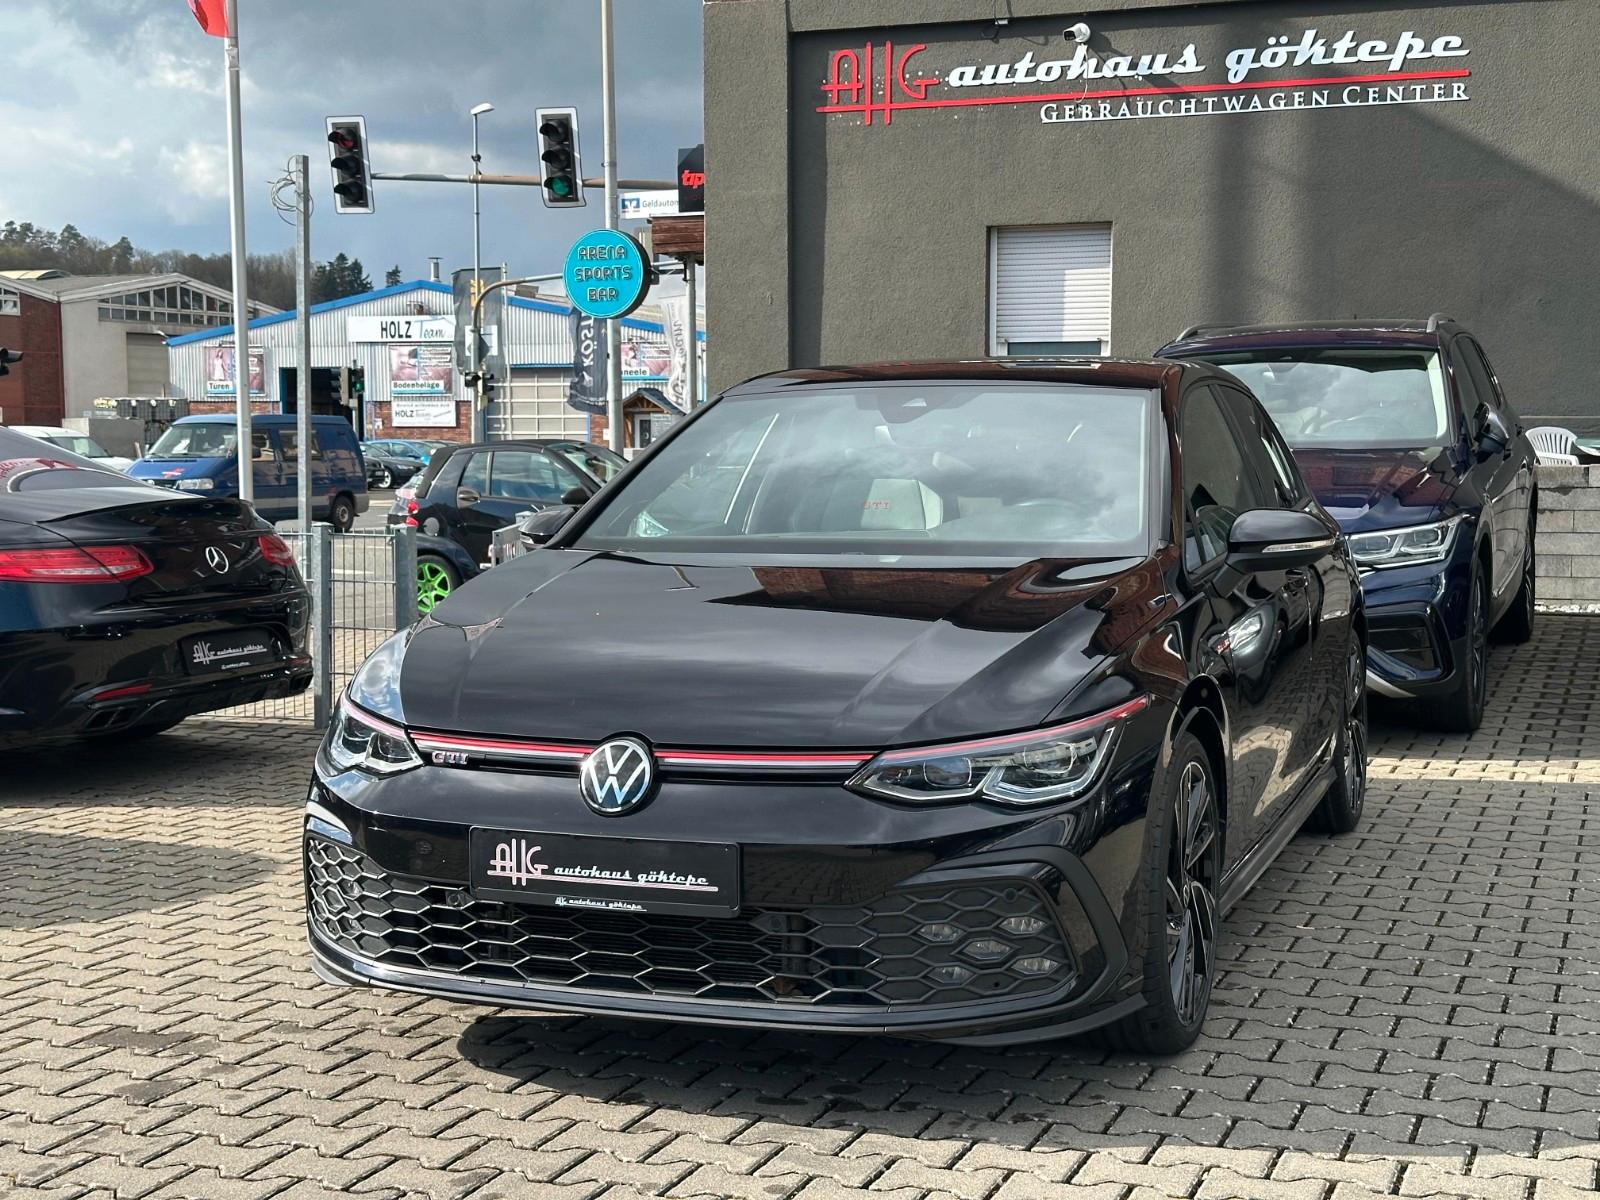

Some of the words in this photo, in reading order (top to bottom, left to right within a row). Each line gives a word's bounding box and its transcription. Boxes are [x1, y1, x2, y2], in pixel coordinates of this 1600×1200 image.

[821, 41, 940, 125] AHG
[949, 43, 1206, 88] autohaus
[1225, 29, 1470, 84] göktepe
[1040, 90, 1329, 122] GEBRAUCHTWAGEN
[1342, 82, 1471, 104] CENTER
[578, 245, 627, 260] ARENA
[574, 265, 632, 282] SPORTS
[587, 287, 618, 302] BAR
[381, 321, 412, 338] HOLZ
[432, 751, 469, 764] GTI
[487, 838, 549, 886] AHG
[554, 865, 632, 880] autohaus
[637, 870, 709, 886] göktepe
